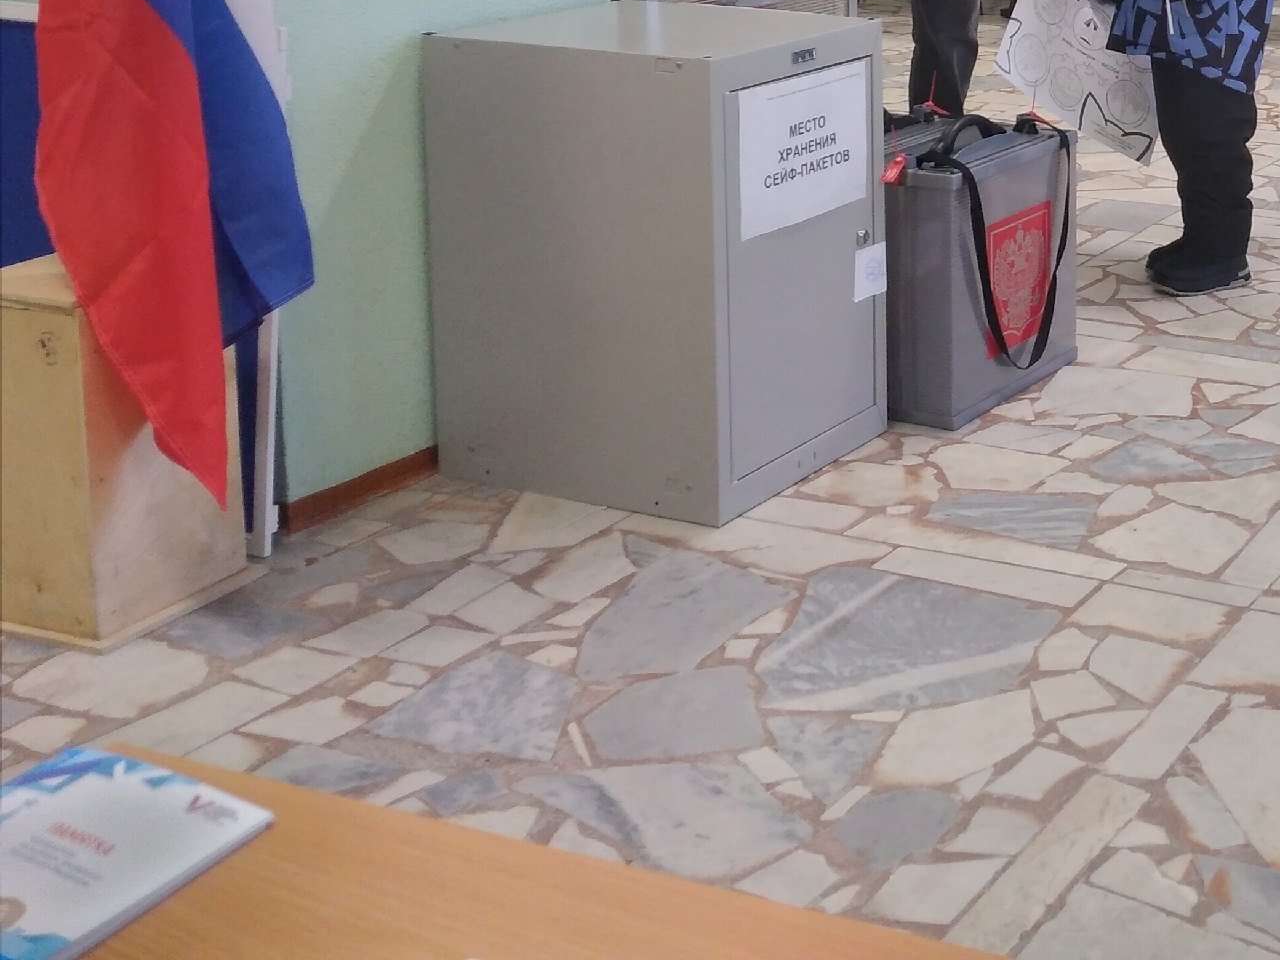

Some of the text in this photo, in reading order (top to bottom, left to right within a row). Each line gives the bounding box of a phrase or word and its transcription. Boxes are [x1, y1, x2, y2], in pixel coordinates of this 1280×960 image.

[789, 115, 826, 139] МЕСТО
[778, 132, 837, 164] ХРАНЕНИЯ
[764, 149, 850, 189] СЕЙФ-ПАКЕТОВ
